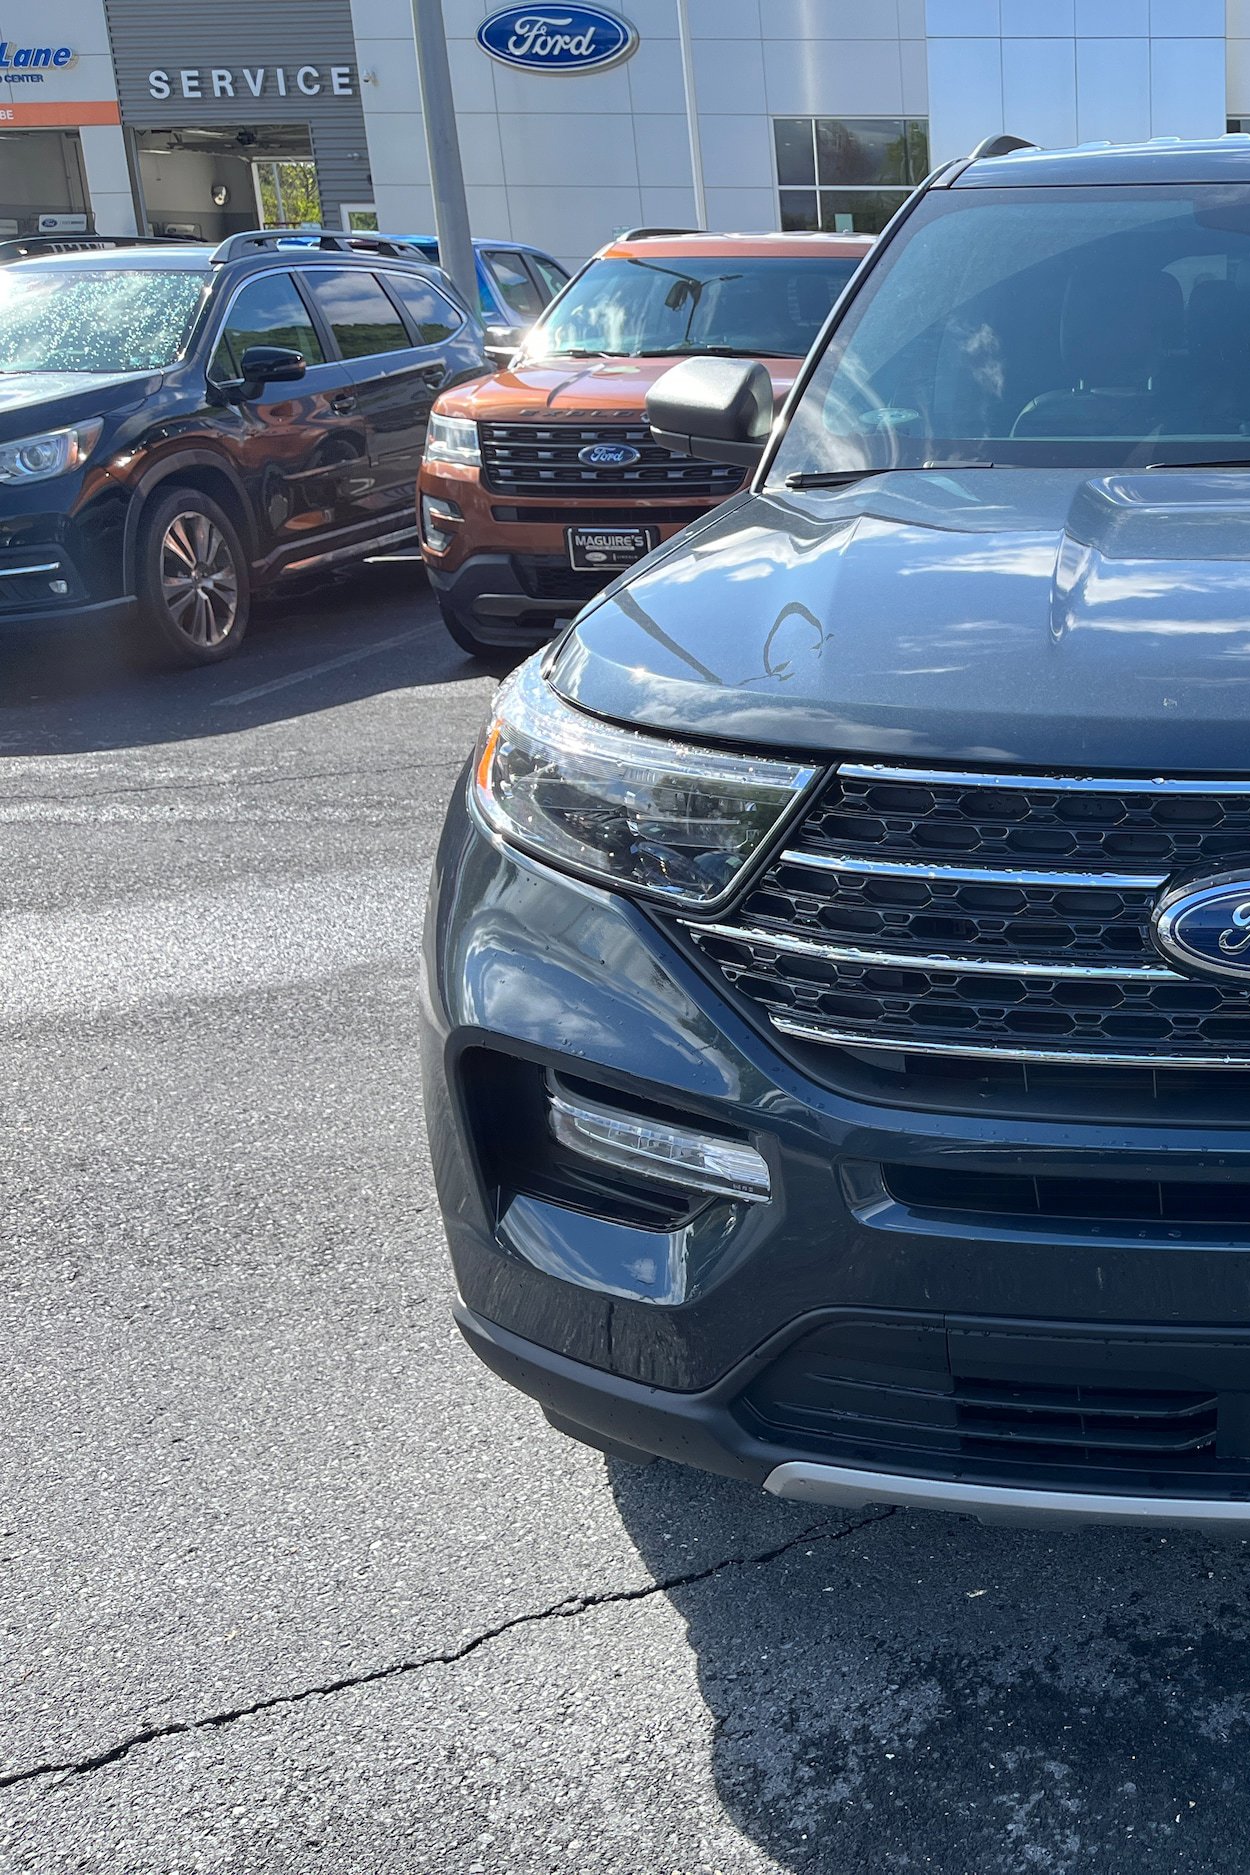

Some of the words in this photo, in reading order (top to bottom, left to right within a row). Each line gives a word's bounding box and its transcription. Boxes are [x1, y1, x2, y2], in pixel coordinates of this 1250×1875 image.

[508, 16, 596, 56] Ford
[0, 41, 72, 69] Lane
[4, 74, 44, 83] CENTER
[148, 65, 353, 100] SERVICE
[590, 446, 624, 462] Ford
[575, 535, 644, 548] MAGUIRE'S
